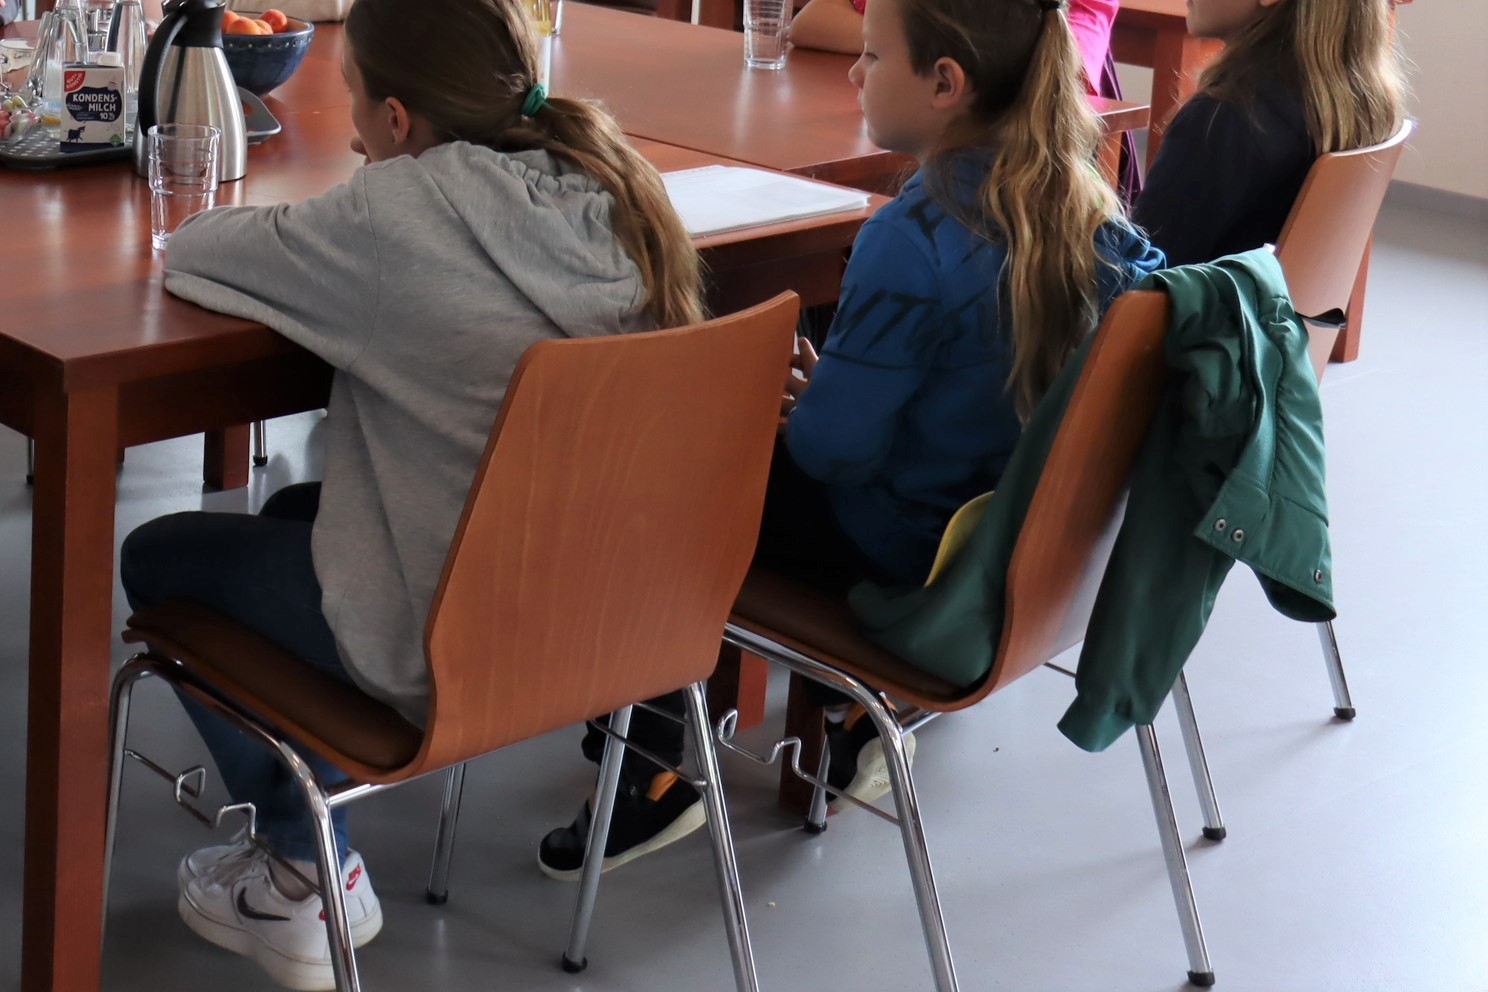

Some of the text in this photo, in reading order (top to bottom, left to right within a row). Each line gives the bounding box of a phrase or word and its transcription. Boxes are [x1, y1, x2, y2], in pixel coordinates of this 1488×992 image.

[73, 94, 118, 102] KONDENS-
[88, 103, 116, 112] MILCH
[99, 112, 108, 120] 10
